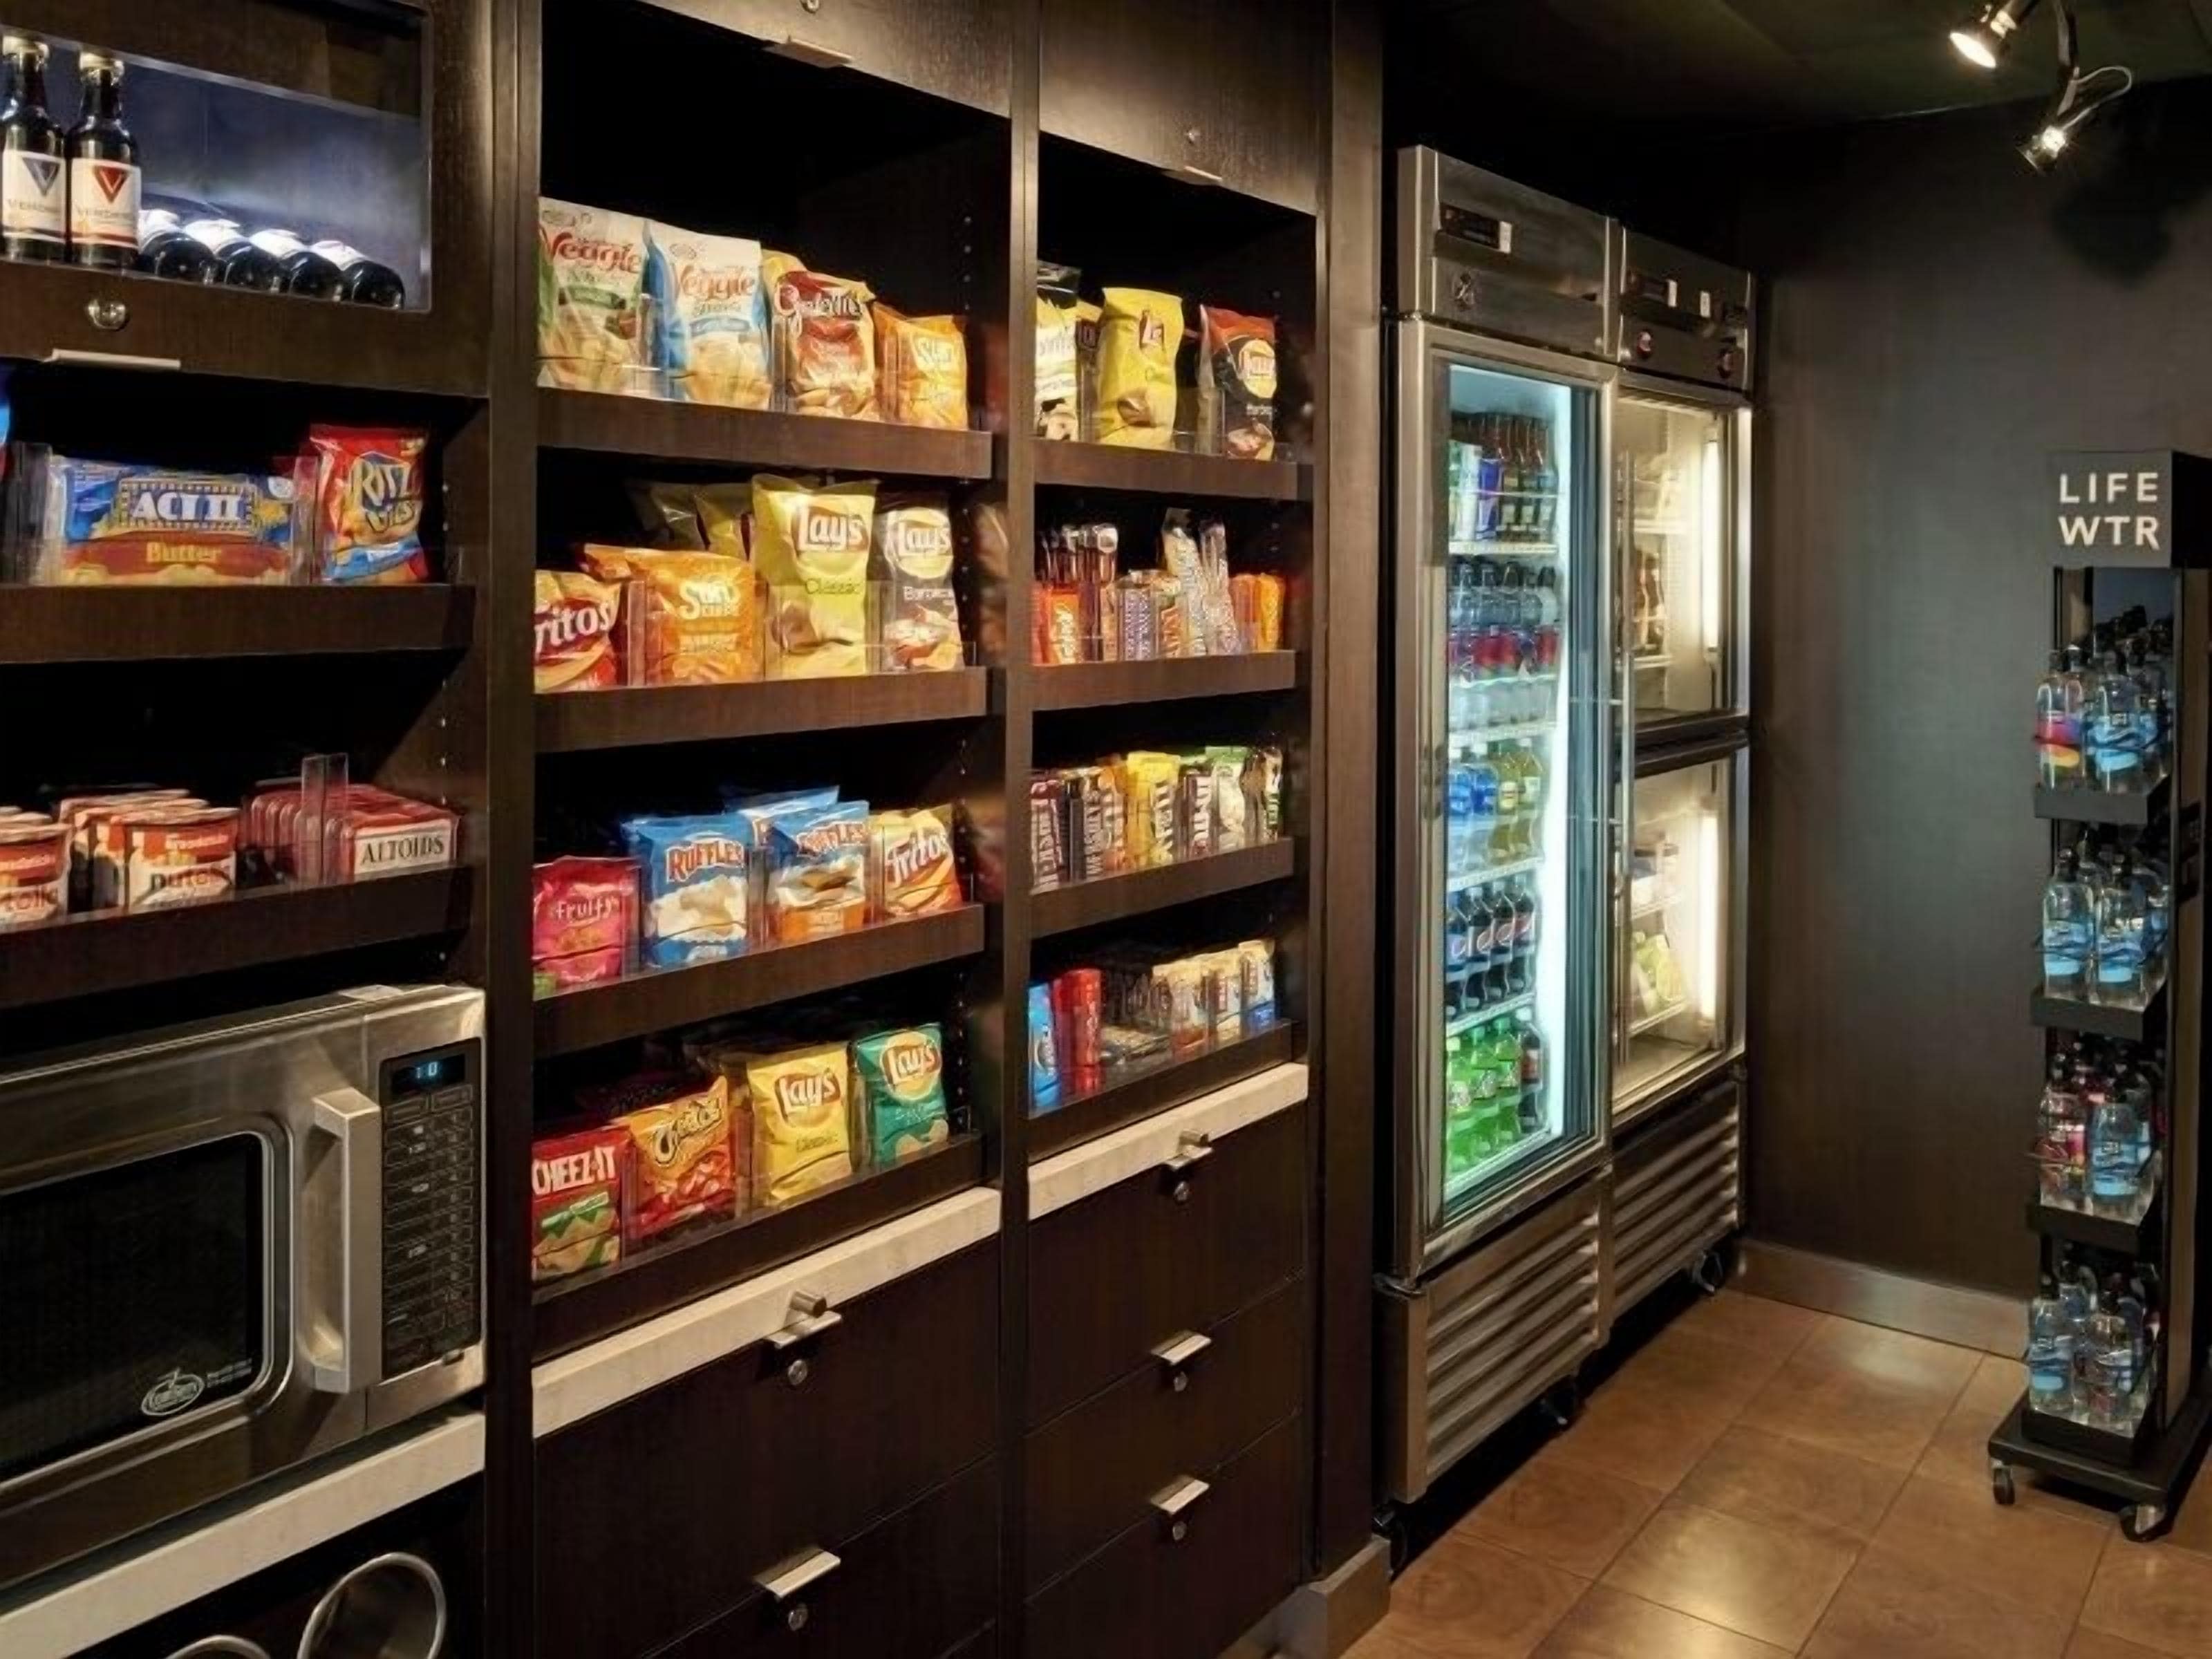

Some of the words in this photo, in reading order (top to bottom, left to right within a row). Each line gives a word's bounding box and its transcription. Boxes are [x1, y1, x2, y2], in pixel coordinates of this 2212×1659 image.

[351, 457, 411, 509] RITZ
[2059, 472, 2158, 503] LIFE
[132, 491, 203, 521] ACT
[2058, 516, 2160, 551] WTR
[146, 542, 222, 564] Butter
[360, 833, 444, 865] ALTOIDS
[666, 837, 744, 883] RUFFLES
[532, 1146, 616, 1195] CHEEZ-IT
